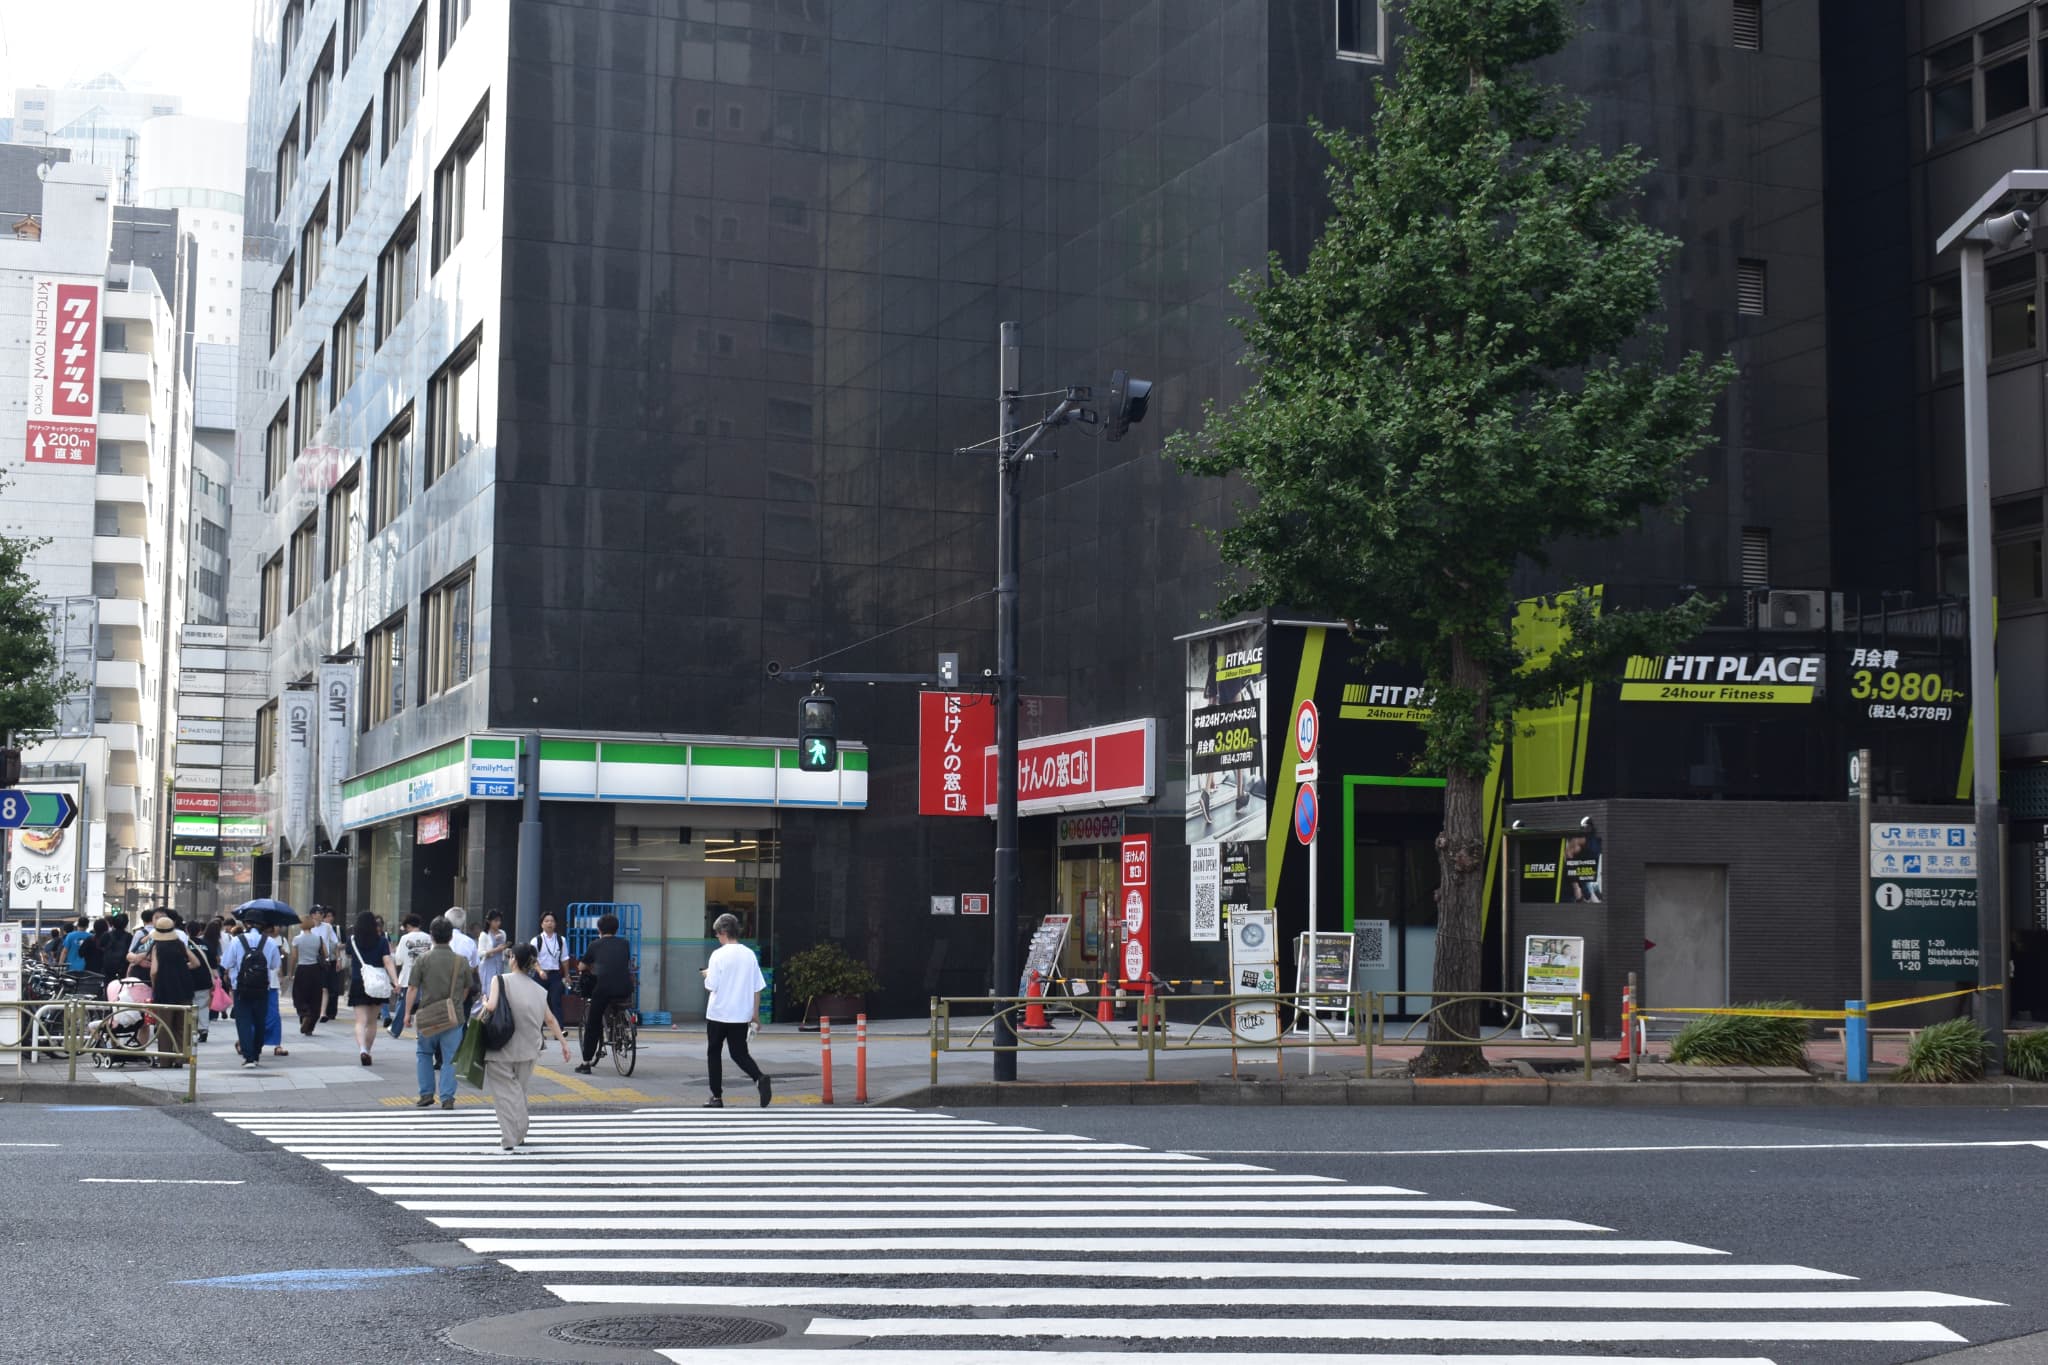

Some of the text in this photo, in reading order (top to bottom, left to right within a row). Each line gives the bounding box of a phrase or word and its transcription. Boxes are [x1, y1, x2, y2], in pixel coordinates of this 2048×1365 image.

[34, 281, 49, 416] KITCHEN TOWN TOKYO
[59, 298, 91, 404] クリナップ
[48, 432, 90, 448] 200m
[55, 448, 82, 461] 直進
[1226, 647, 1263, 668] FIT PLACE
[1850, 648, 1899, 669] 月会費
[1663, 655, 1820, 682] FIT PLACE
[1369, 685, 1402, 705] FIT
[1661, 687, 1775, 700] 24hour Fitness
[329, 680, 347, 727] GMT
[1366, 708, 1433, 719] 24hour Fitne
[291, 706, 308, 748] GMT
[1301, 718, 1312, 744] 40
[943, 697, 961, 812] ほけんの窓口
[471, 763, 513, 773] FamilyMart
[1018, 750, 1083, 792] けんの窓口
[489, 785, 509, 795] たばこ
[2, 797, 17, 820] 8
[176, 798, 216, 807] ほけんの窓口
[176, 825, 215, 833] FamilyMart
[1881, 827, 1942, 839] JR 新宿駅
[1539, 864, 1556, 872] PLACE
[1904, 899, 1939, 907] Shinjuku
[1940, 899, 1956, 908] City
[1892, 939, 1920, 949] 新宿区
[1928, 939, 1945, 947] 1-20
[1892, 950, 1920, 960] 西新宿
[1897, 961, 1921, 971] 1-20
[1927, 958, 1978, 967] Shinjuku City
